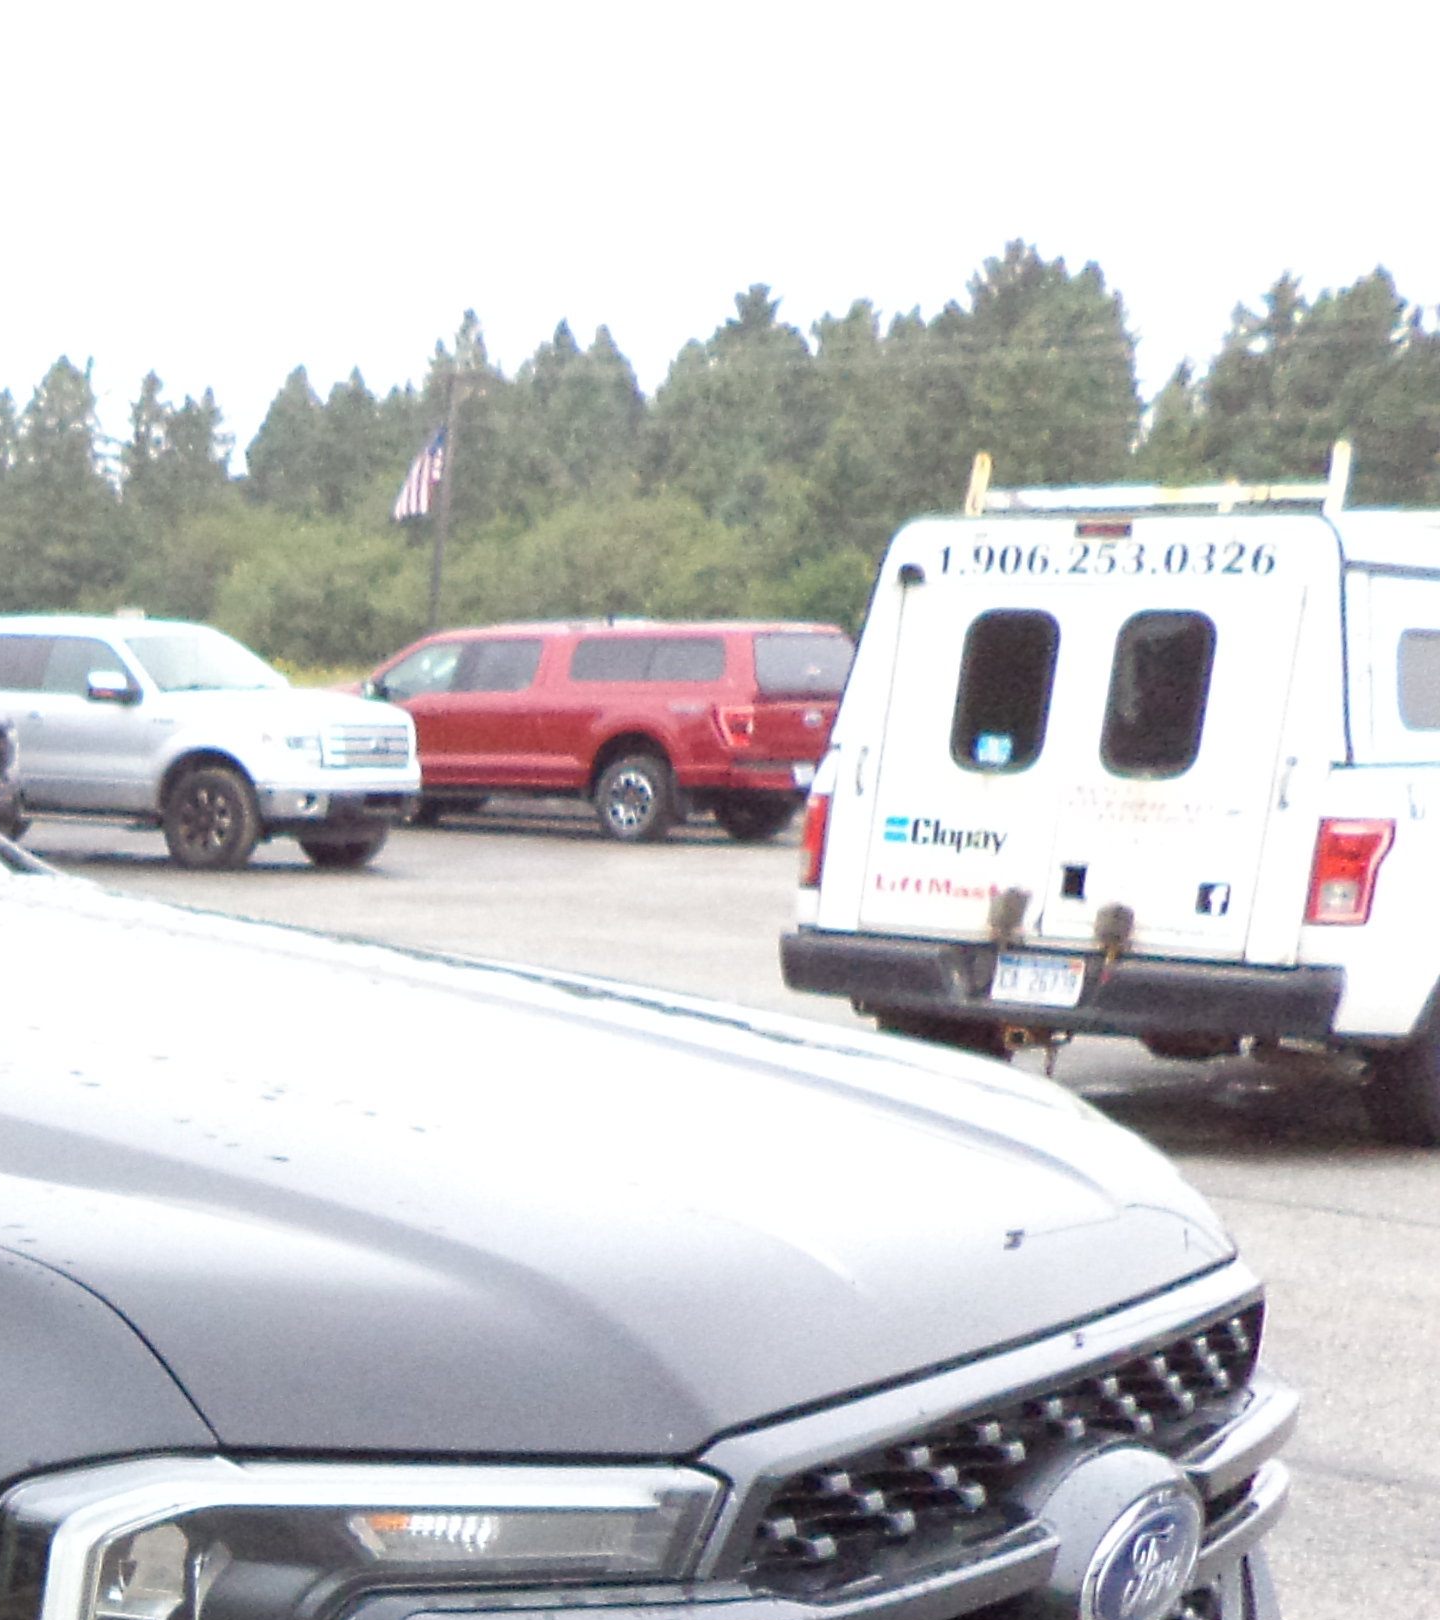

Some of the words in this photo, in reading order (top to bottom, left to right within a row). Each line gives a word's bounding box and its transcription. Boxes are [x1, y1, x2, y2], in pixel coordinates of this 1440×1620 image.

[938, 540, 1277, 576] 1.906.253.0326
[911, 818, 1008, 855] Clopay
[876, 874, 1032, 899] LiftMast
[1121, 1523, 1187, 1618] Ford
